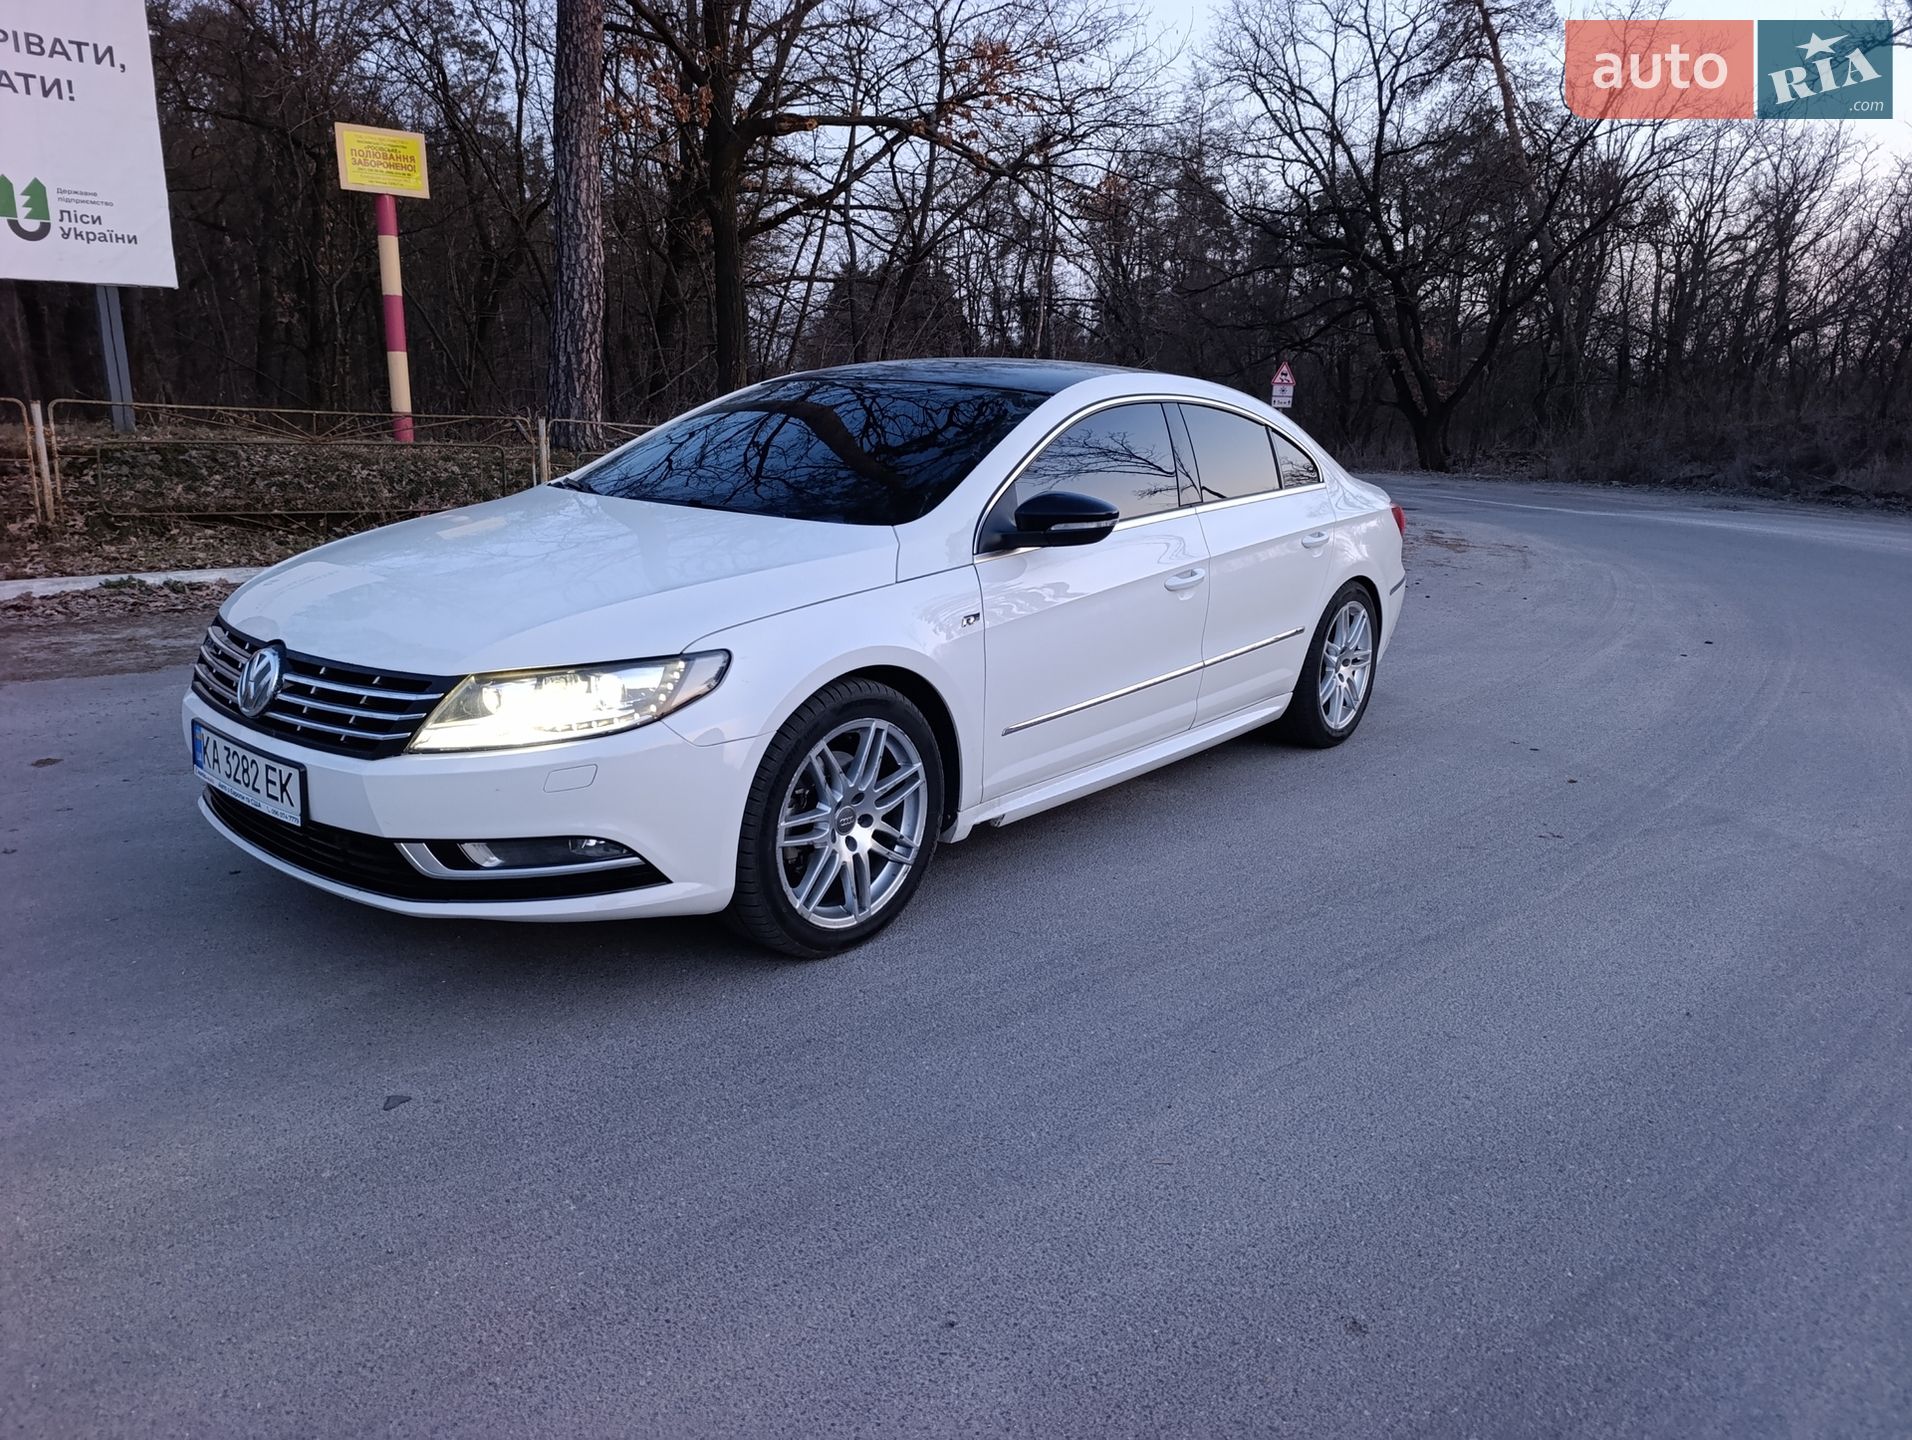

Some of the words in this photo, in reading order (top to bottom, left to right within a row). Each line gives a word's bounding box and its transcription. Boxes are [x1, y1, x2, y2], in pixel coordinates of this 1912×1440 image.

[350, 148, 416, 163] ПОЛЮВАННЯ
[352, 158, 417, 173] ЗАБОРОНЕНО!
[57, 187, 98, 197] Державне
[59, 209, 102, 226] Ліси
[60, 226, 138, 245] України
[201, 733, 221, 774] KA
[223, 745, 261, 794] 3282
[265, 764, 295, 808] EK
